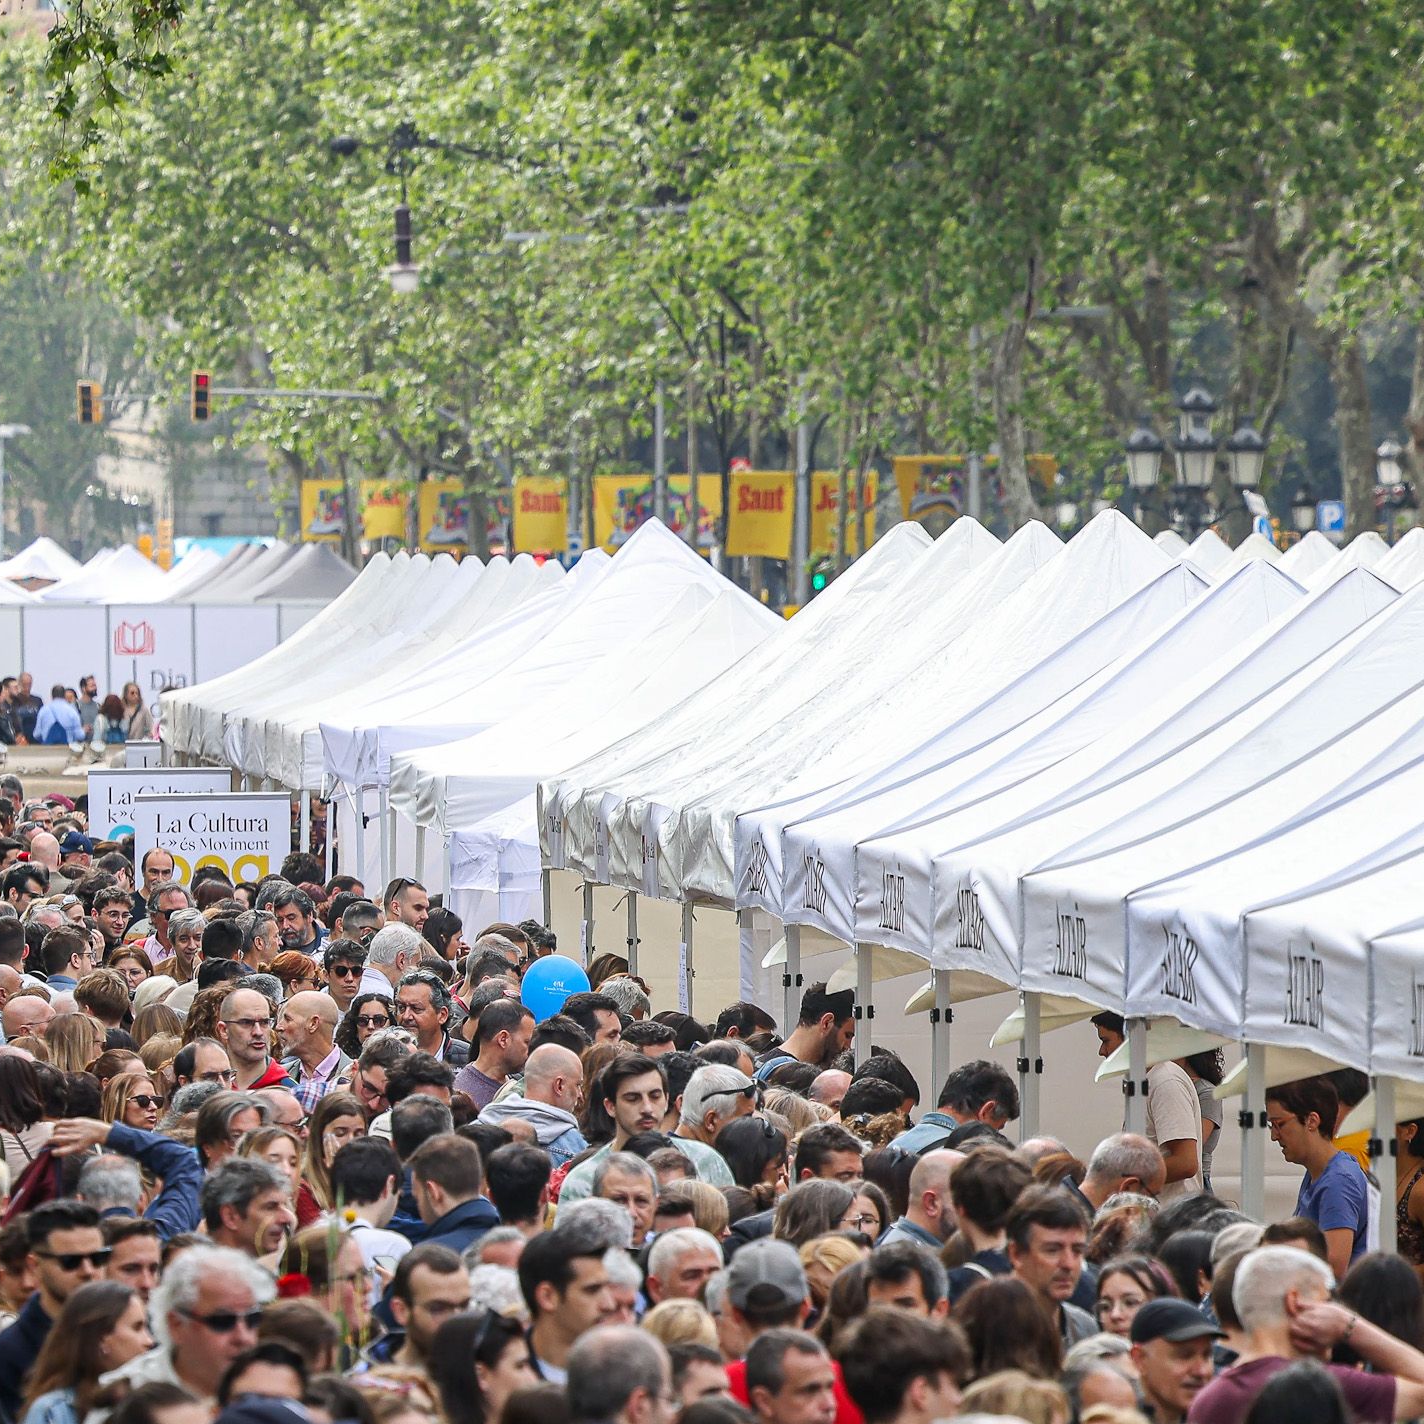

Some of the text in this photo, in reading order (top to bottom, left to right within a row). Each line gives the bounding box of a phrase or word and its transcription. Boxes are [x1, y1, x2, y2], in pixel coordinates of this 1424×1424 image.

[738, 484, 784, 512] Sant
[1324, 504, 1340, 529] P
[108, 786, 131, 805] La
[156, 813, 181, 833] La
[188, 812, 268, 833] Cultura
[200, 837, 269, 851] Moviment
